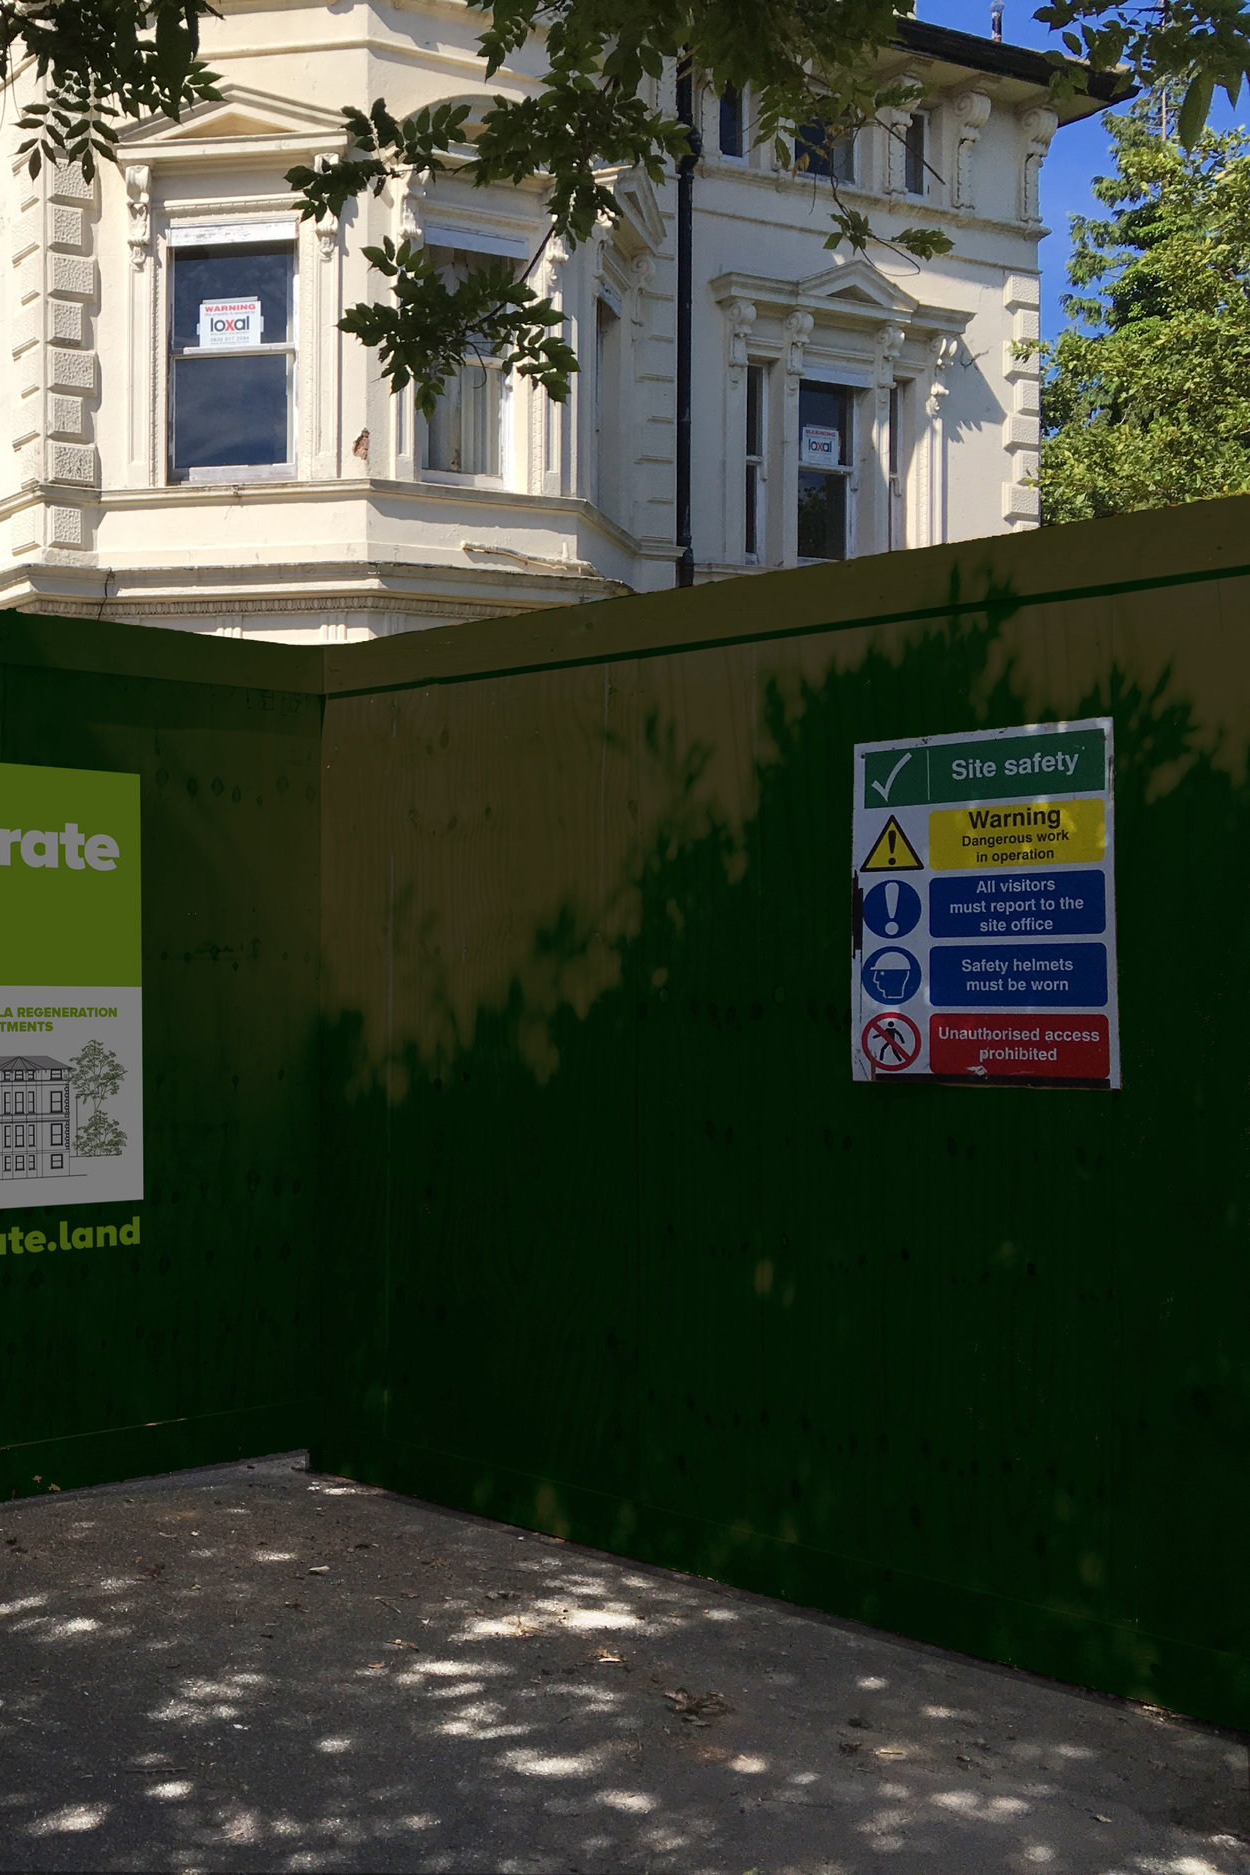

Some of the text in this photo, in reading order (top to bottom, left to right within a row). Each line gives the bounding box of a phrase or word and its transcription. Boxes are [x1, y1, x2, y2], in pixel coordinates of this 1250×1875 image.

[205, 304, 255, 312] WARNING
[211, 316, 249, 332] loxal
[809, 439, 832, 452] loxal
[952, 751, 1079, 780] Site safety
[968, 807, 1061, 829] Warning
[962, 829, 1069, 848] Dangerous work
[976, 848, 1054, 864] in operation
[976, 879, 1056, 893] All visitors
[950, 896, 1084, 915] must report to the
[980, 917, 1053, 932] site office
[961, 958, 1074, 975] Safety helmets
[966, 978, 1069, 991] must be worn
[17, 1007, 118, 1018] REGENERATION
[939, 1026, 1100, 1042] Unauthorised access
[979, 1047, 1057, 1063] prohibited
